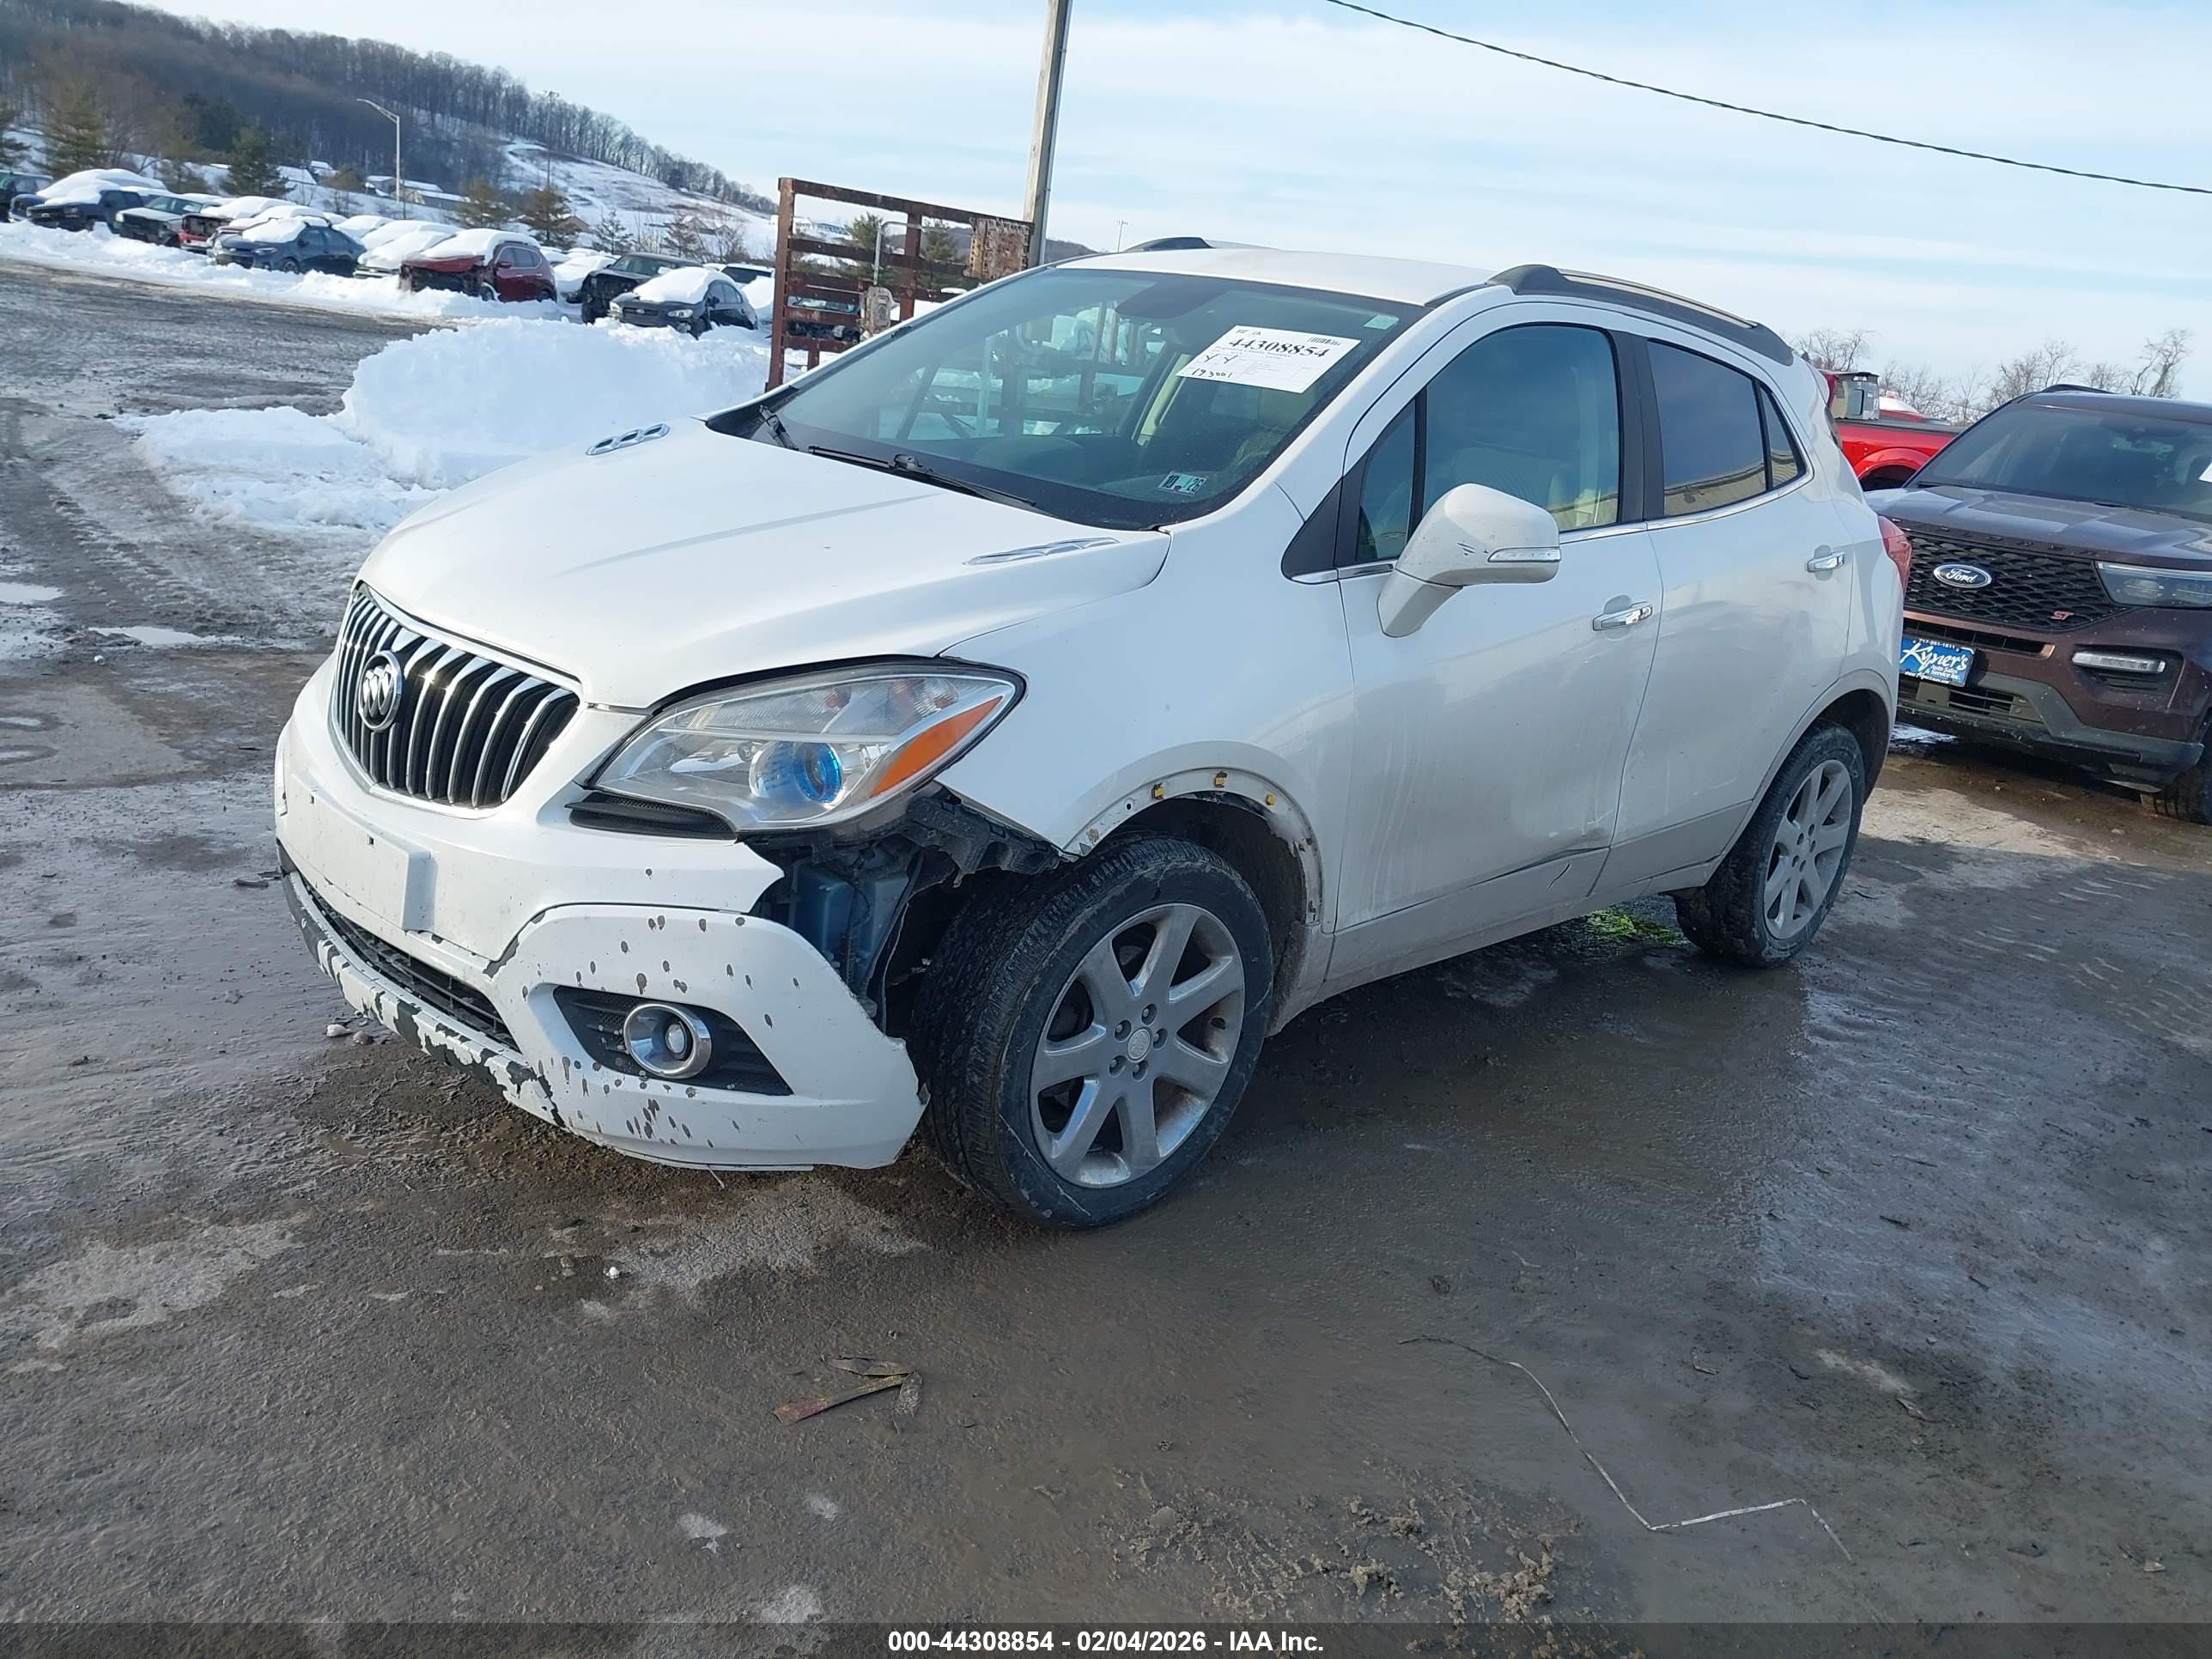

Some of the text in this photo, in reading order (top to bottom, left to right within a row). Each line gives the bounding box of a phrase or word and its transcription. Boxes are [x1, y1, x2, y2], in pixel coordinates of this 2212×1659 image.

[1229, 338, 1330, 357] 44308854
[1946, 568, 1978, 583] Ford
[2051, 611, 2075, 620] ST
[1899, 642, 1969, 672] Kyner's
